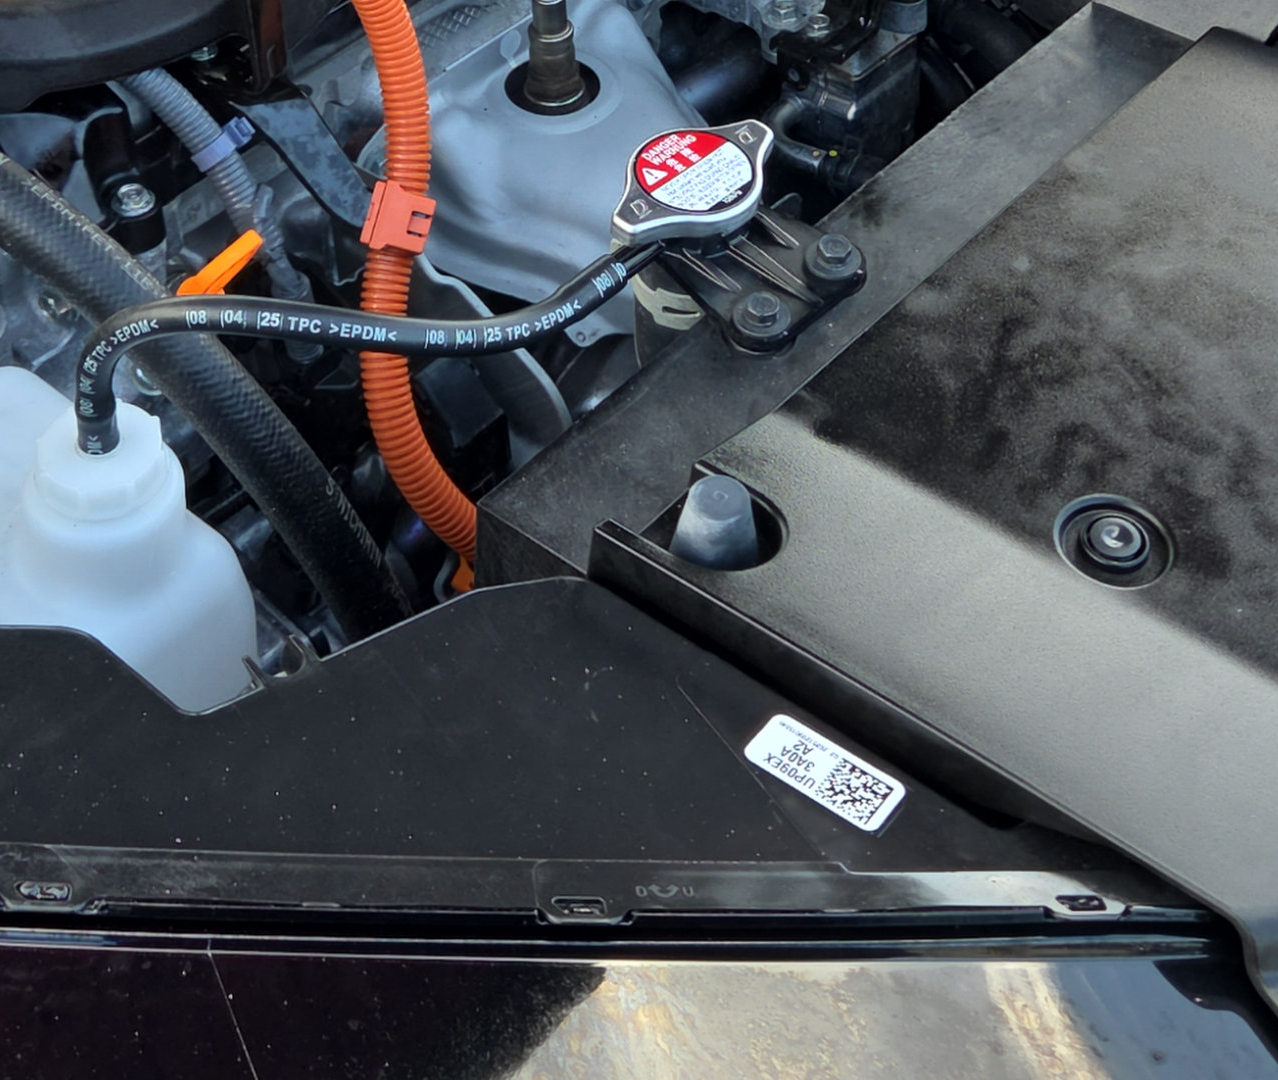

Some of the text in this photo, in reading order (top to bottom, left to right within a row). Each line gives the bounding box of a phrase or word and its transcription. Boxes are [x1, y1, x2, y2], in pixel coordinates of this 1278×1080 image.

[641, 133, 682, 162] DANGER
[287, 316, 322, 334] TPC
[505, 322, 531, 341] TPC
[792, 739, 814, 756] A2
[763, 752, 816, 789] UP09EX
